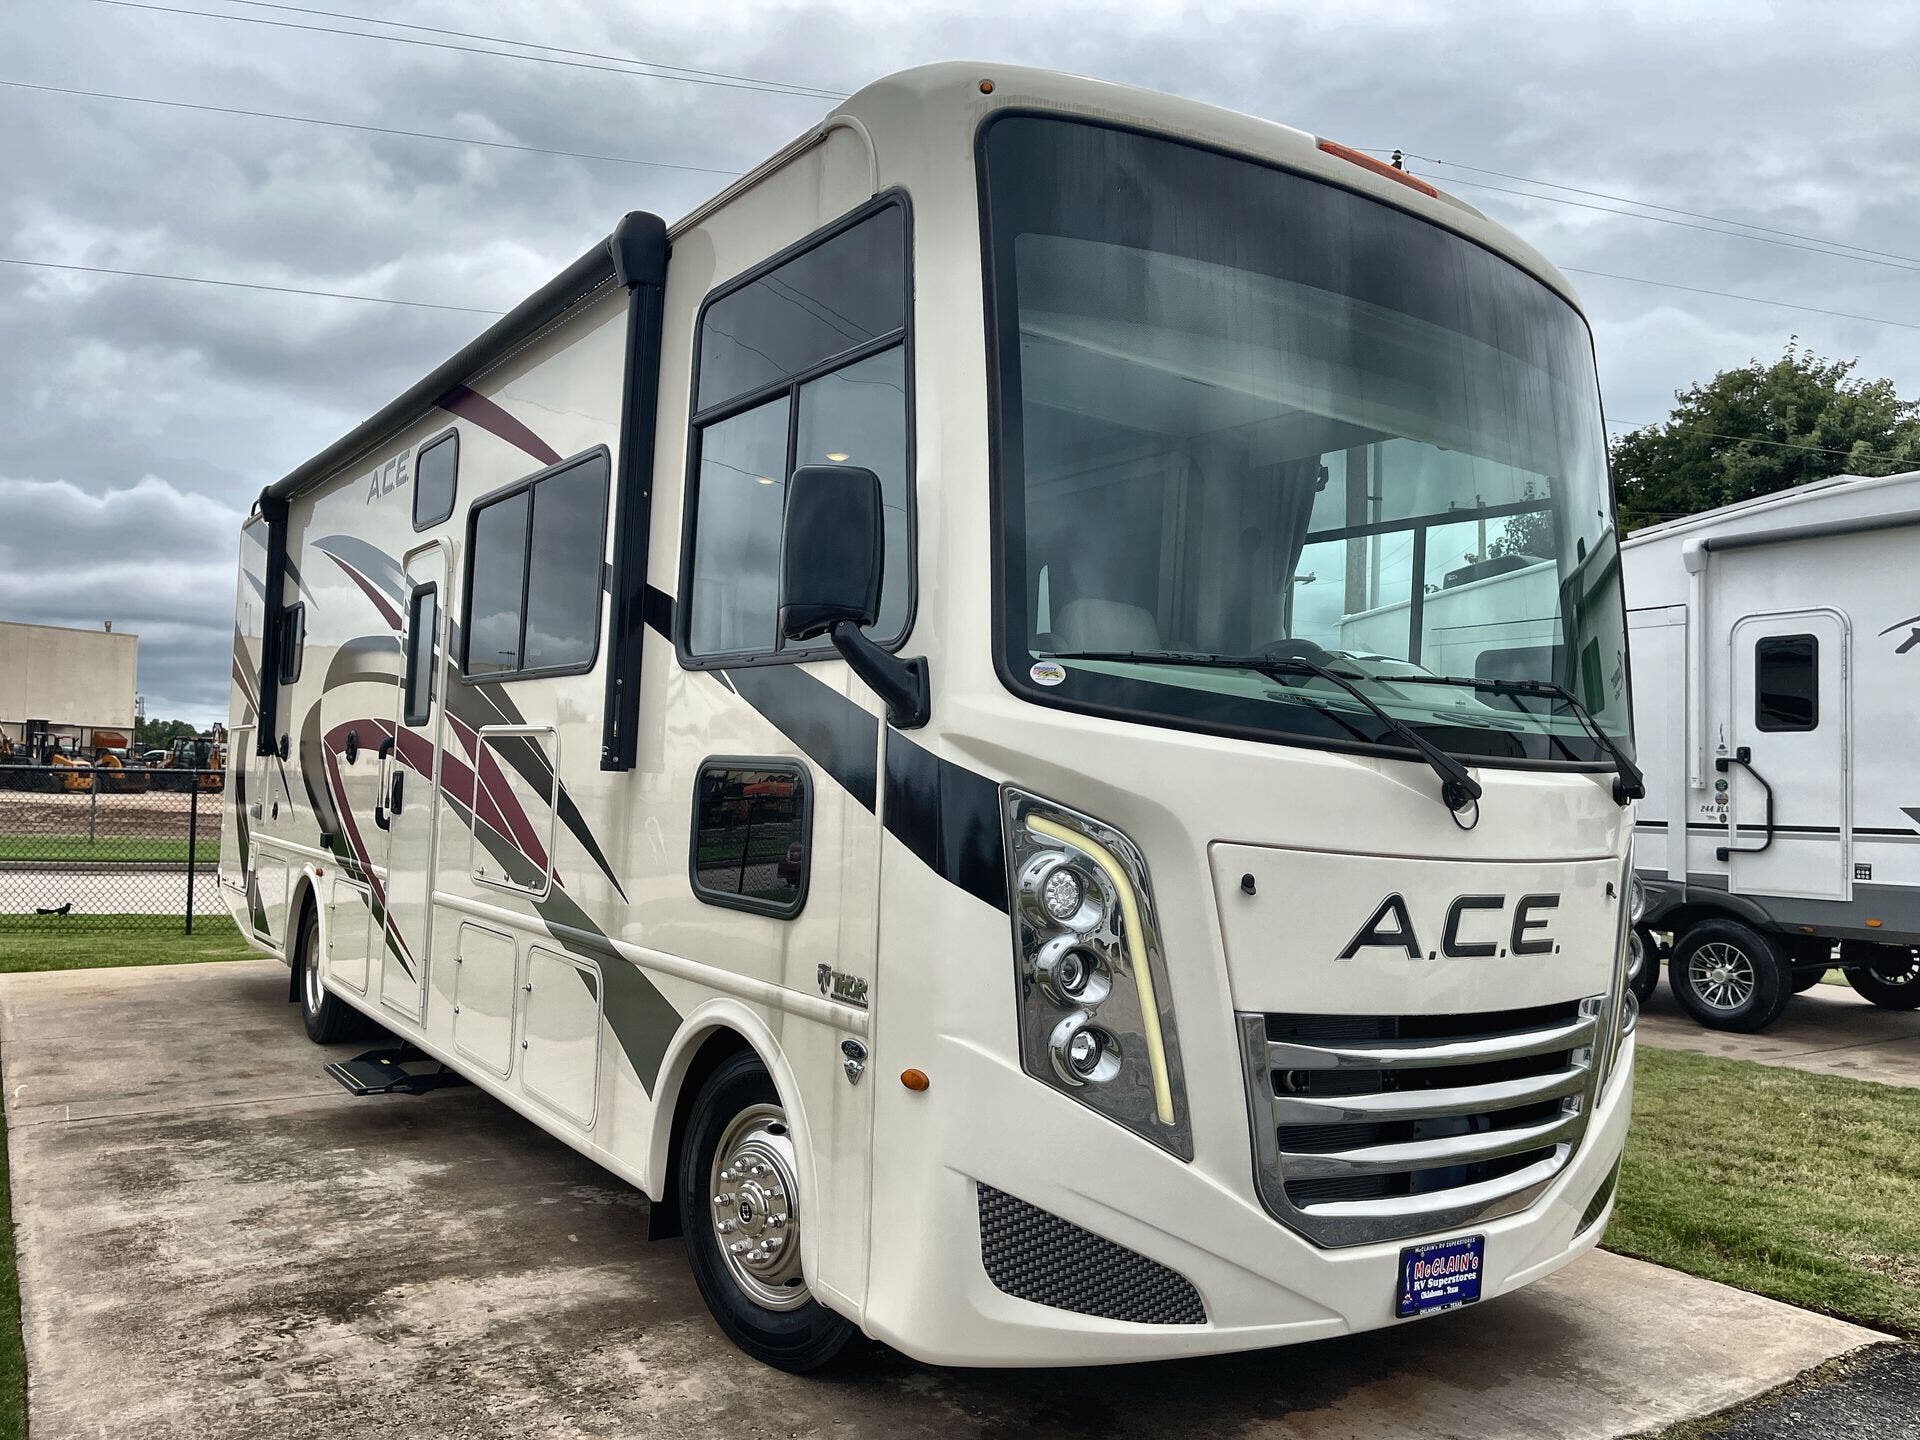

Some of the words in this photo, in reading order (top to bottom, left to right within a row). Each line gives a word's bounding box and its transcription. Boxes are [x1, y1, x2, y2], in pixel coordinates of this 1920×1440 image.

[1700, 805, 1714, 813] 244
[1333, 892, 1561, 961] A.C.E.
[831, 970, 869, 1001] THOR
[1414, 1252, 1479, 1279] McCLAIN's
[1414, 1279, 1427, 1291] RV
[1427, 1272, 1477, 1288] Superstores
